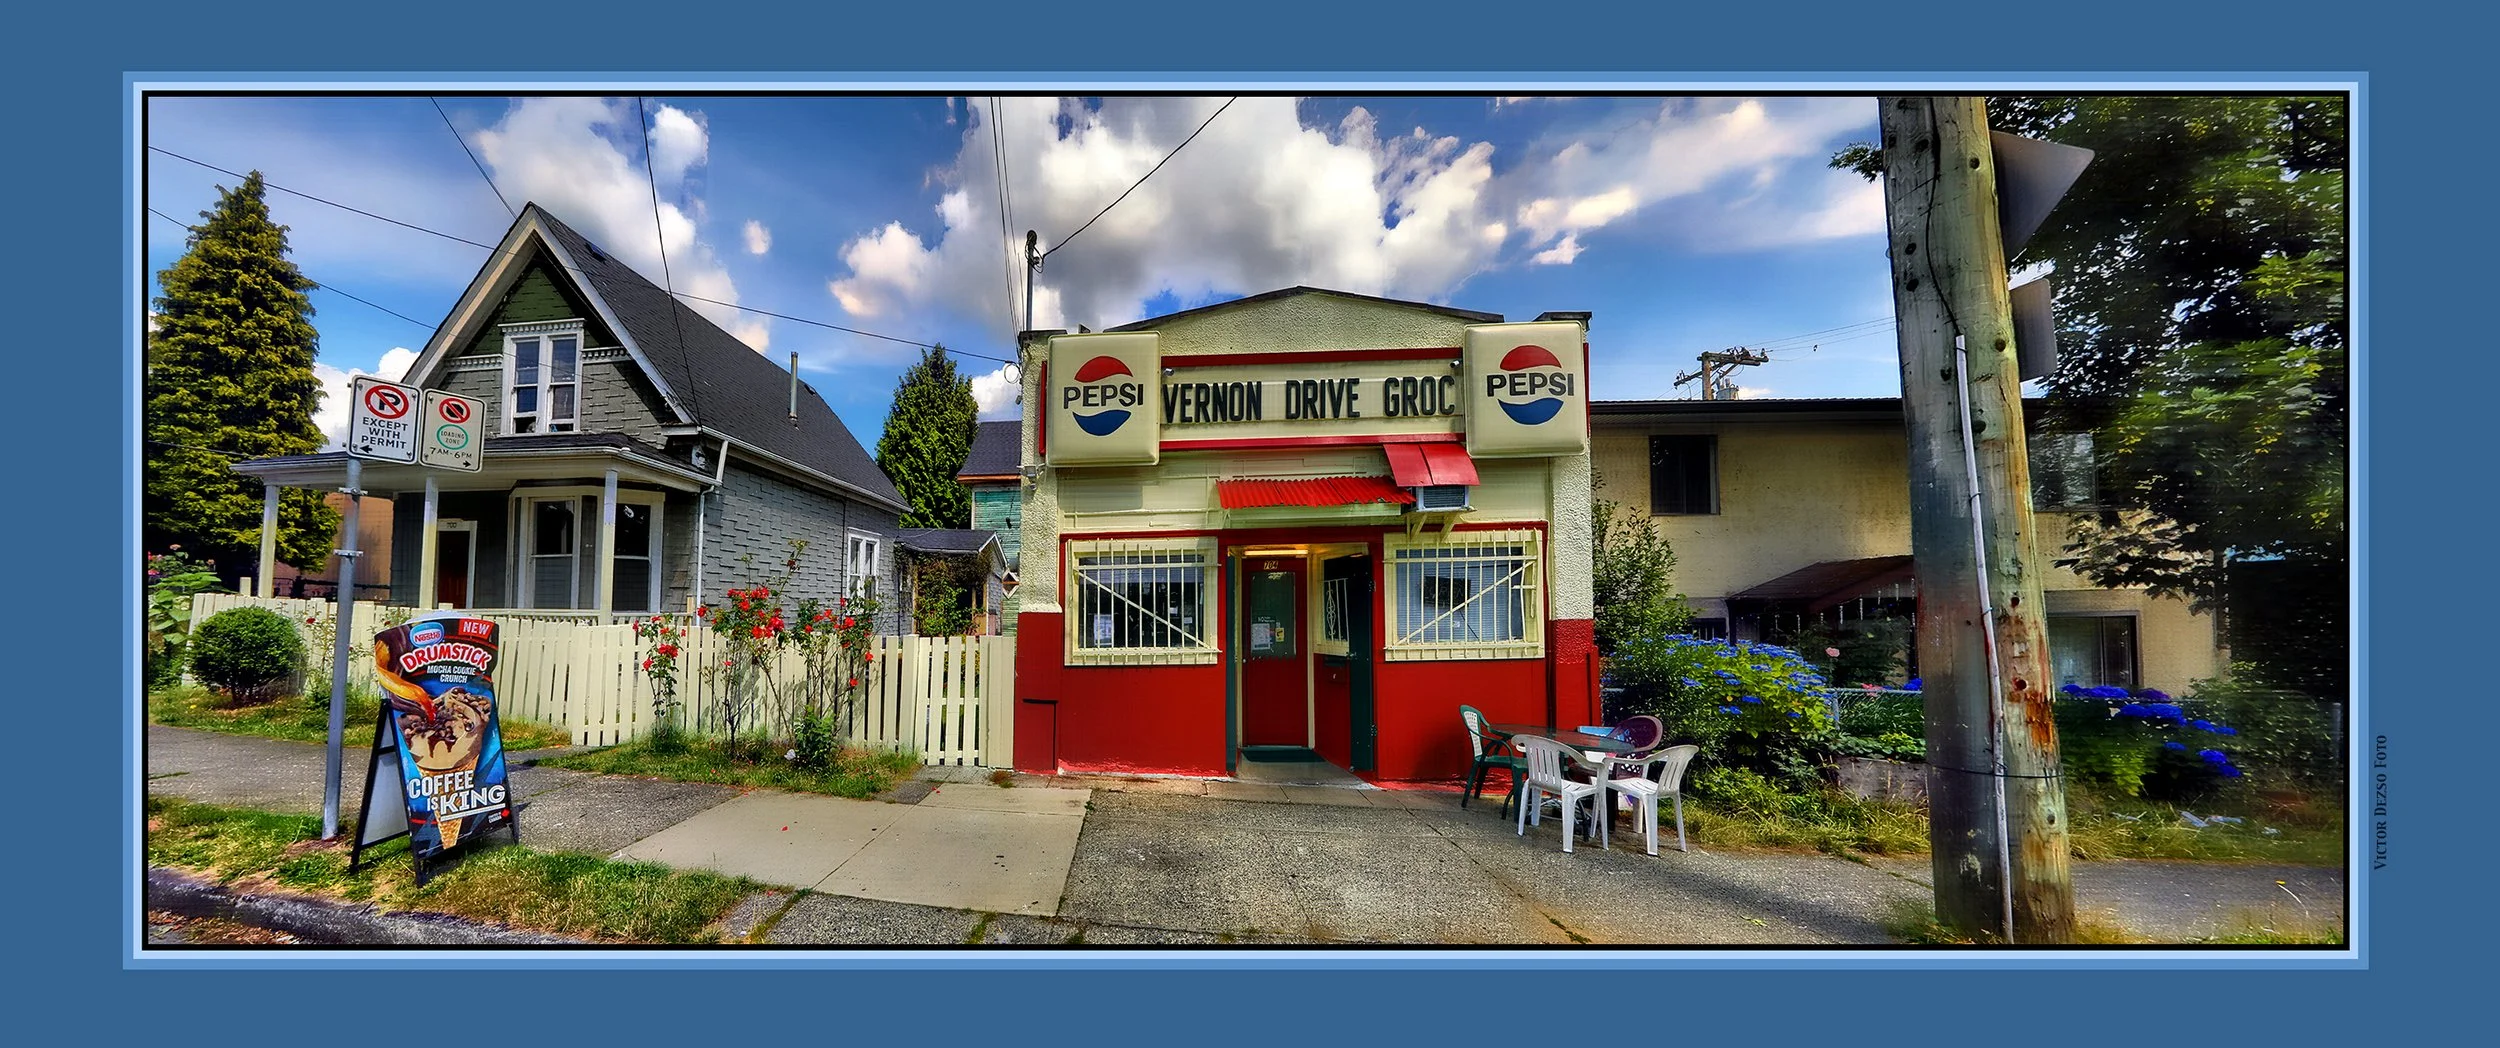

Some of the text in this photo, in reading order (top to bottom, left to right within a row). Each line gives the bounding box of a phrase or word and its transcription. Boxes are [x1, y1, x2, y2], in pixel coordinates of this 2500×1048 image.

[1487, 372, 1574, 397] PEPSI
[1063, 383, 1144, 409] PEPSI
[1162, 375, 1455, 423] VERNON DRIVE GROC
[362, 417, 408, 431] EXCEPT
[369, 427, 401, 439] WITH
[441, 430, 465, 440] LOADING
[361, 435, 407, 449] PERMIT
[445, 437, 460, 445] ZONE
[463, 621, 490, 635] NEW
[401, 643, 491, 672] DRUMSTICK
[427, 665, 477, 675] MOCHA COOKIE
[440, 674, 468, 683] CRUNCH
[408, 770, 474, 799] COFFEE
[427, 784, 506, 815] IS KING
